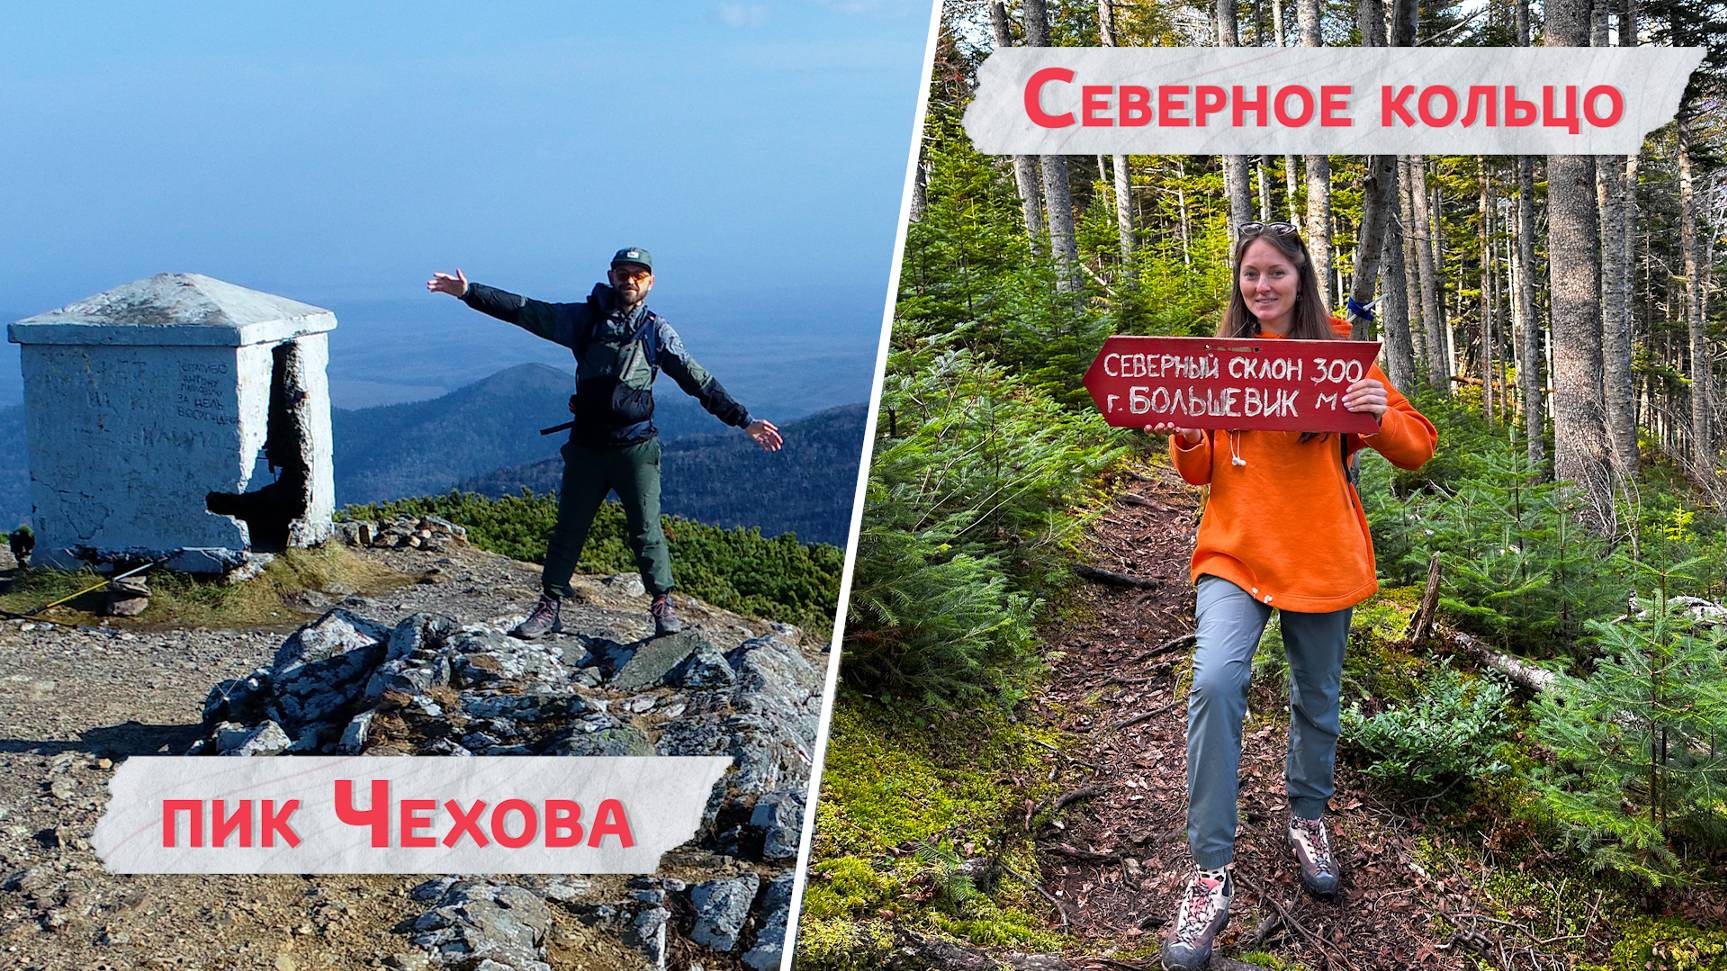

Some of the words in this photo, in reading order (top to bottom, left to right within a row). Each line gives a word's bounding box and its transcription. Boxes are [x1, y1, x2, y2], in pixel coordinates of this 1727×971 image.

[1104, 353, 1219, 379] СЕВЕРНЫЙ
[1228, 356, 1302, 381] СКЛОН
[1311, 357, 1364, 385] 300
[1129, 385, 1300, 417] БОЛЬШЕВИК
